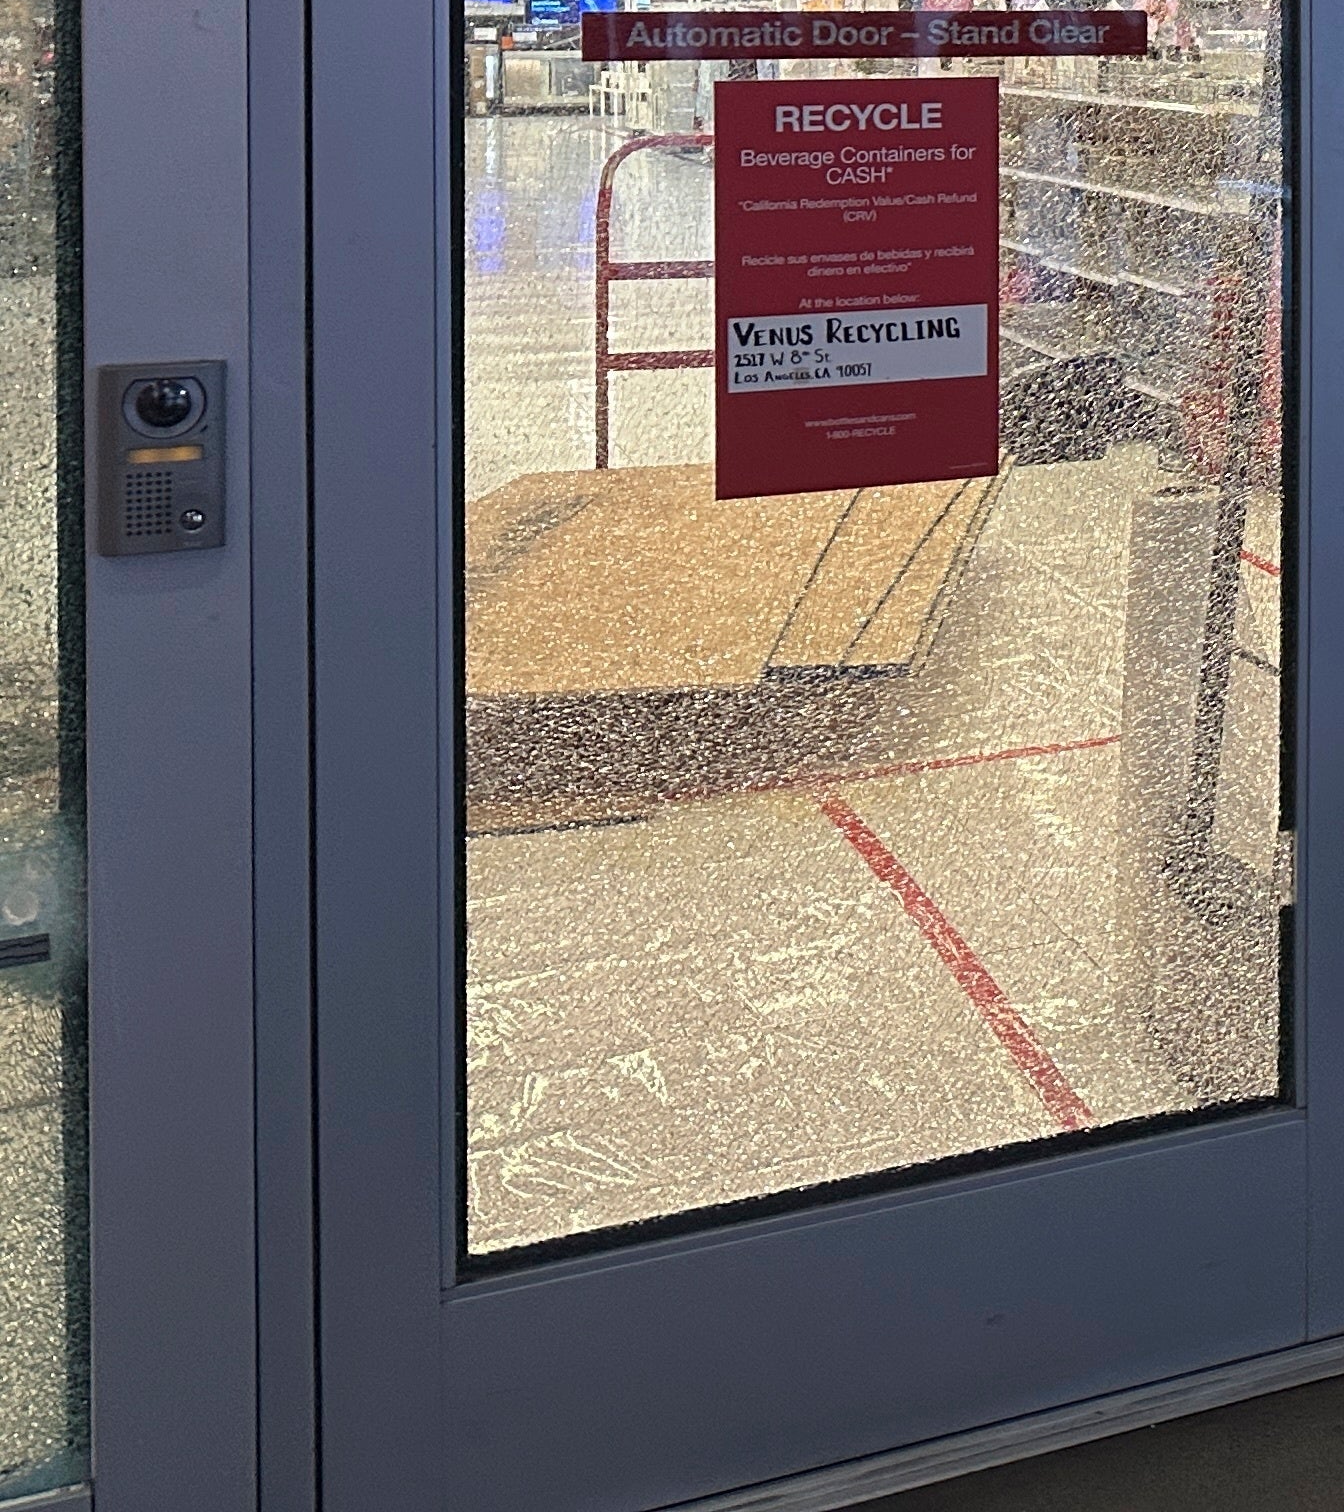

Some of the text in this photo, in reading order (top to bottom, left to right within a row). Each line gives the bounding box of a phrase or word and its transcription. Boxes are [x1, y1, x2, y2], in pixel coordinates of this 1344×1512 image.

[626, 20, 802, 48] Automatic
[812, 20, 894, 46] Door
[927, 19, 1019, 45] Stand
[1029, 18, 1110, 44] Clear
[775, 102, 943, 133] RECYCLE
[740, 144, 976, 169] Beverage Containers for
[800, 196, 870, 211] Redemption
[937, 192, 977, 204] Refund
[787, 255, 808, 265] sus
[859, 251, 875, 262] de
[877, 249, 922, 261] bebidas
[807, 266, 844, 278] dinero
[846, 265, 861, 275] en
[799, 297, 812, 309] At
[814, 296, 833, 308] the
[835, 294, 881, 307] location
[733, 316, 961, 347] VENUS RECYCLING
[734, 352, 765, 368] 2517
[771, 352, 784, 366] W
[814, 368, 831, 379] CA
